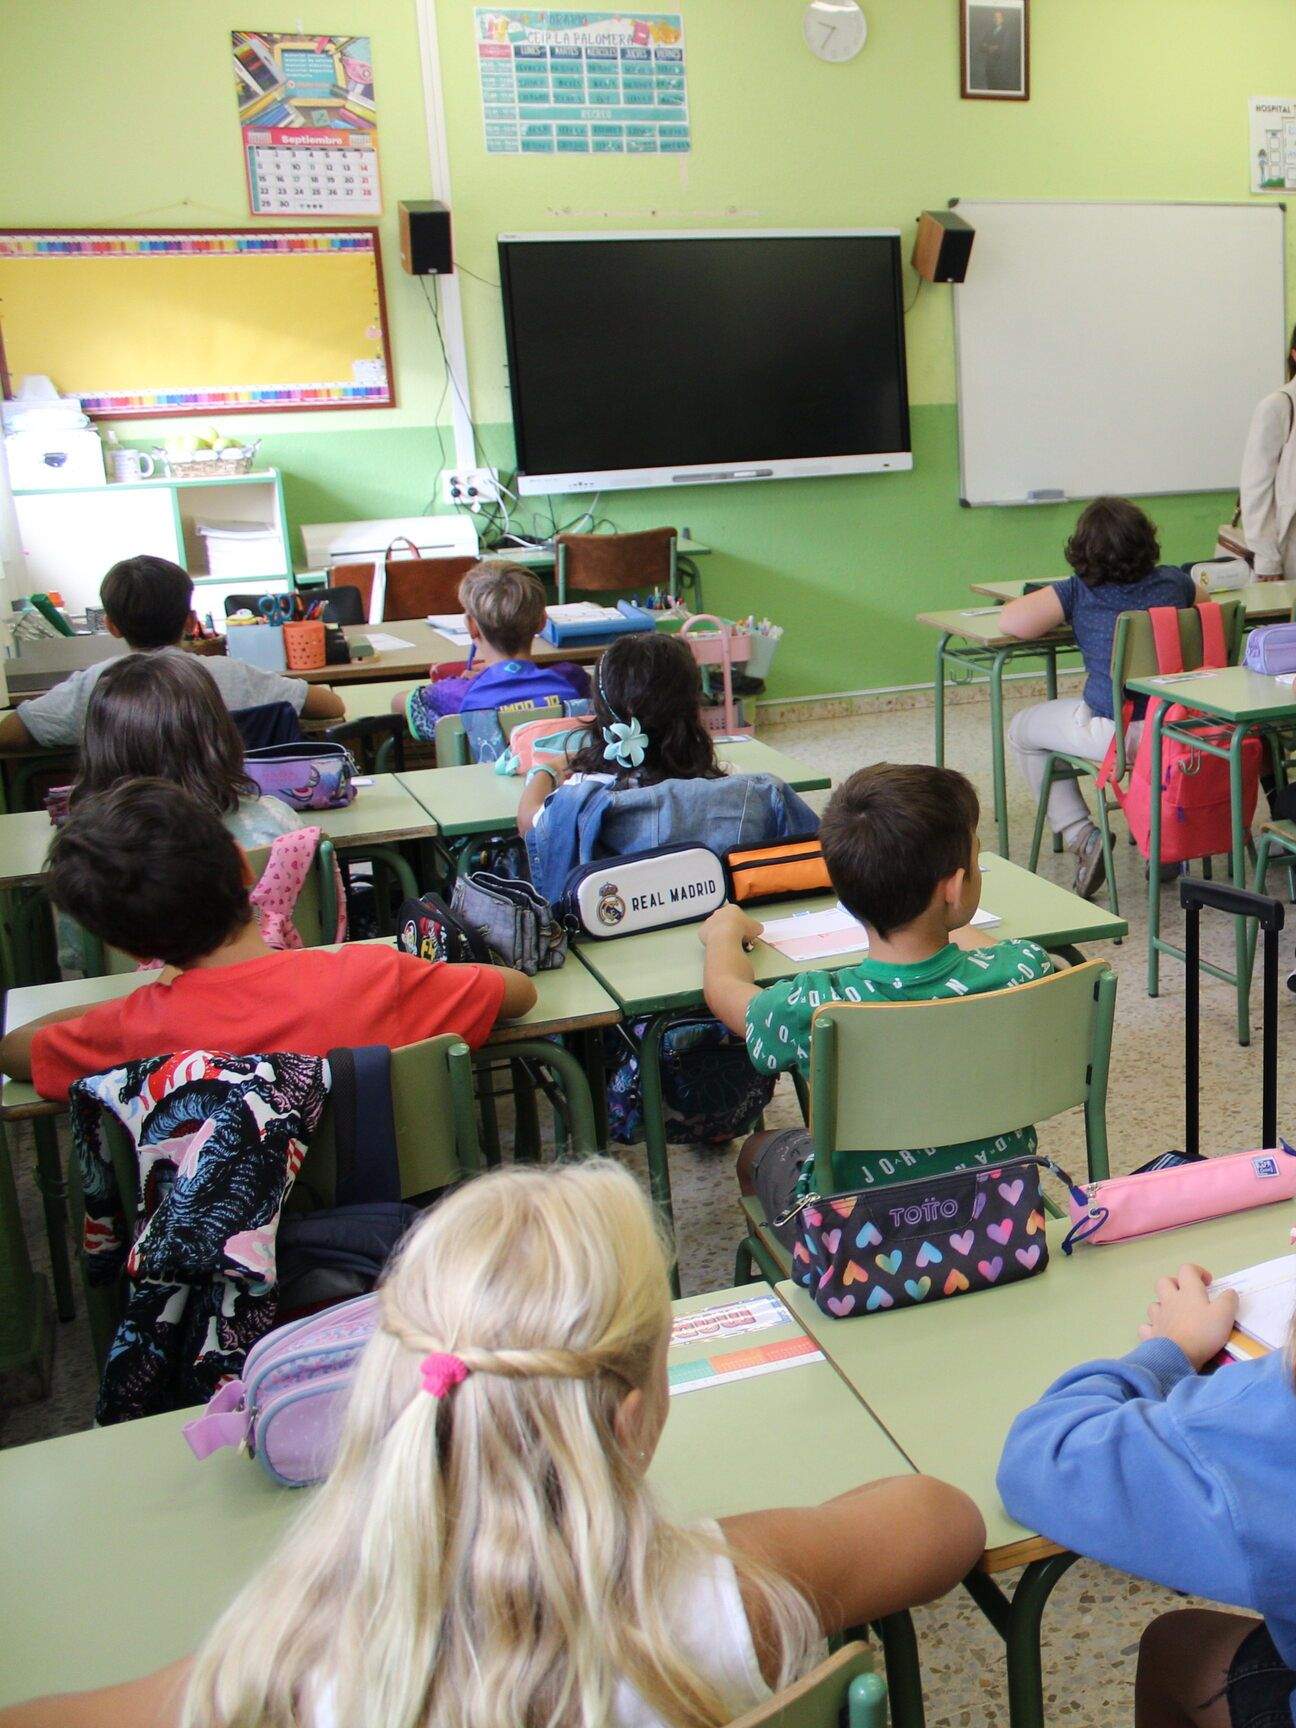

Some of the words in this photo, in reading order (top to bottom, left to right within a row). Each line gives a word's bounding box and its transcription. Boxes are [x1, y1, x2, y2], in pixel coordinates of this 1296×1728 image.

[528, 31, 552, 44] CEIP
[555, 31, 570, 44] LA
[574, 32, 633, 46] PALOMERA
[1255, 104, 1291, 113] HOSPITAL
[281, 135, 343, 145] Septiembre
[632, 893, 665, 911] REAL
[670, 879, 717, 903] MADRID
